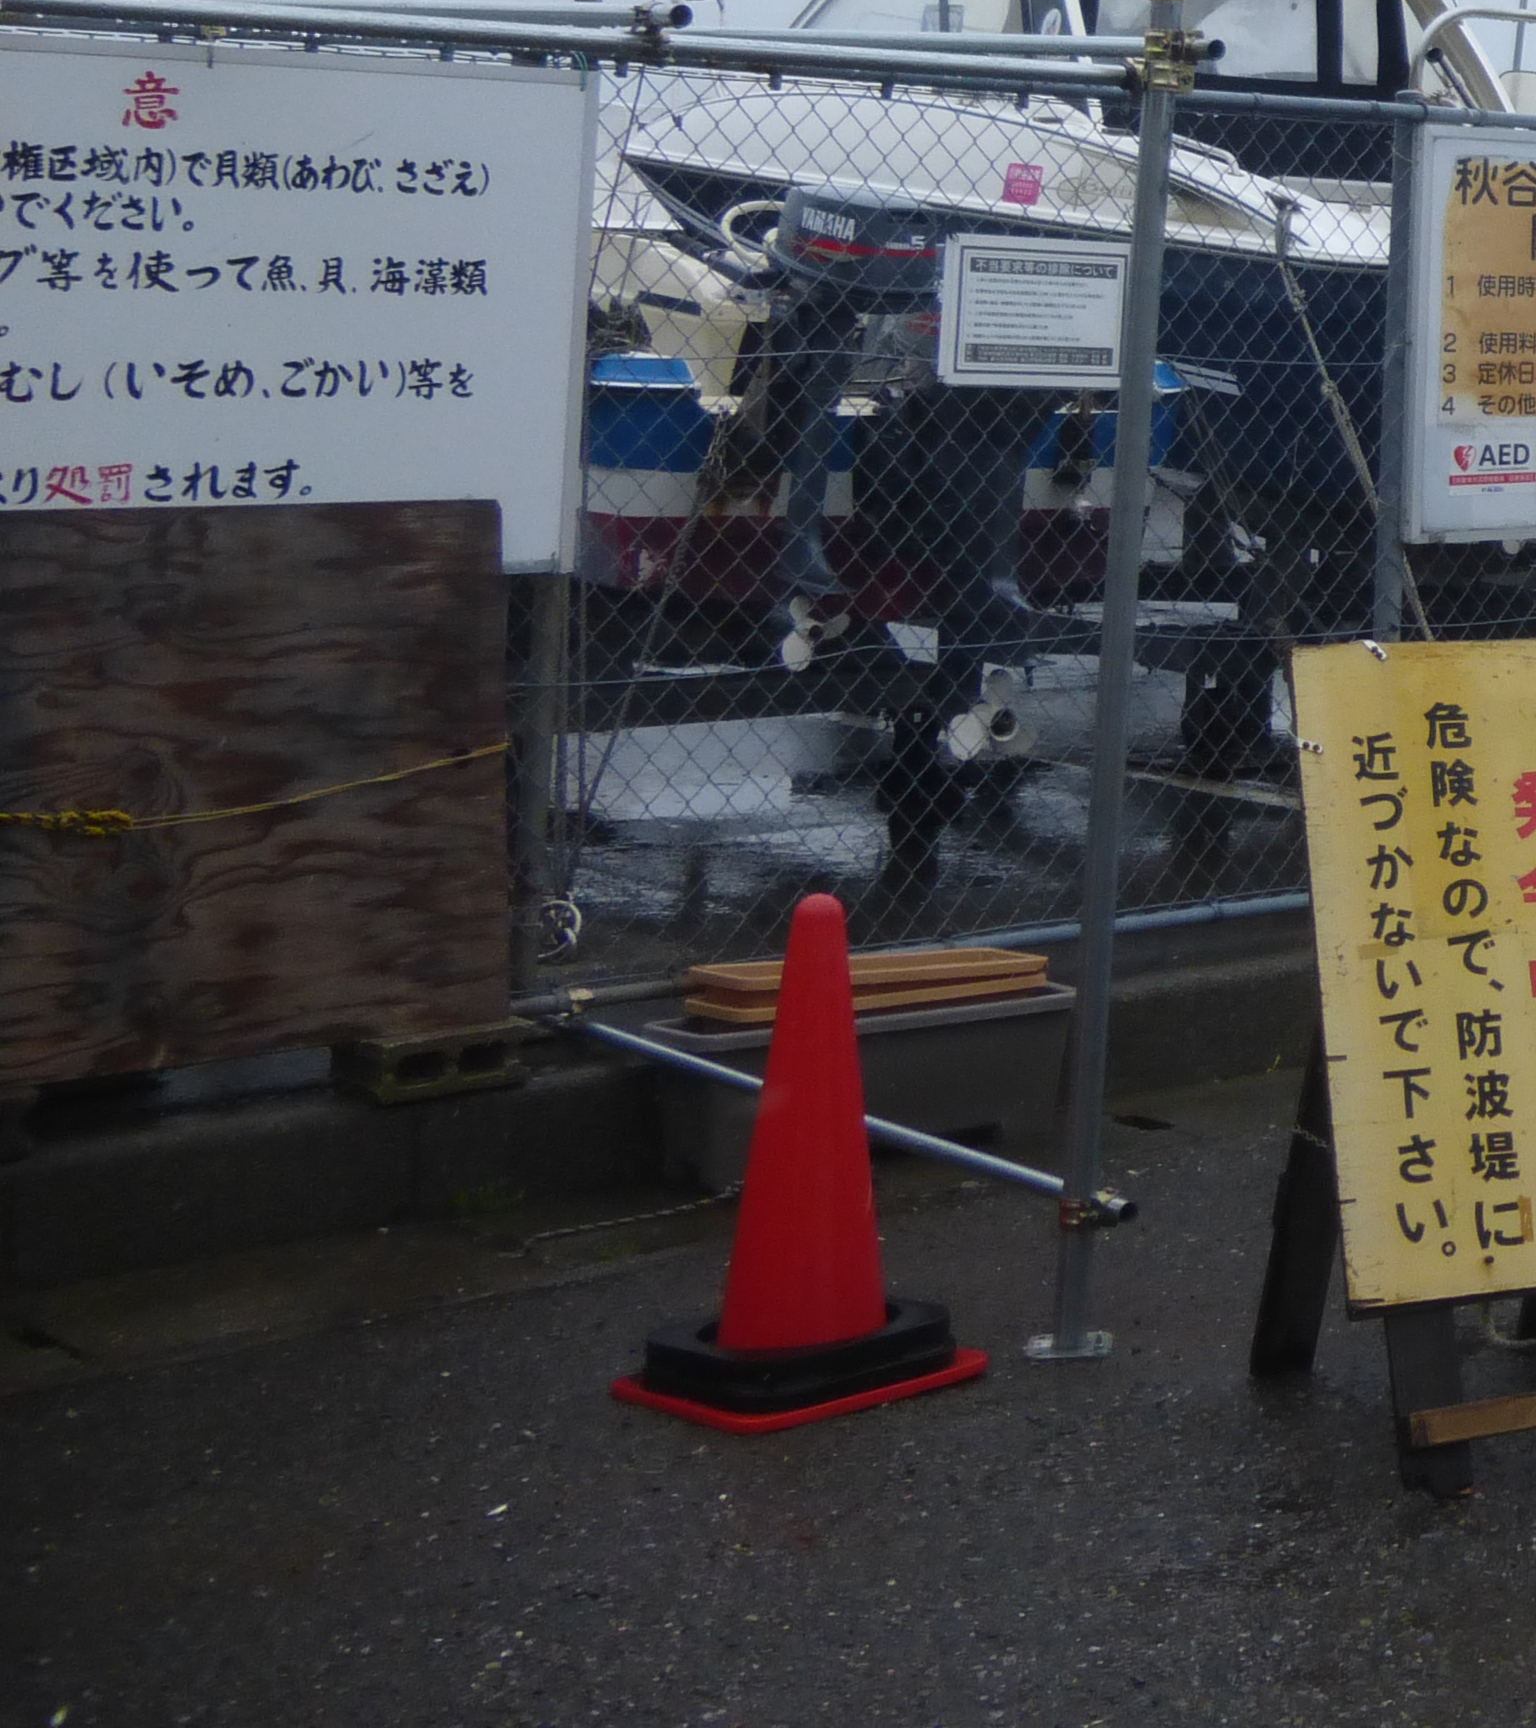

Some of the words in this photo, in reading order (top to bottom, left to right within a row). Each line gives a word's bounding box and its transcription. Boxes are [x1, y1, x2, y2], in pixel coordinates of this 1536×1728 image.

[121, 71, 179, 129] 意
[802, 207, 856, 242] YAMAHA
[1446, 275, 1456, 297] 1
[1443, 333, 1457, 354] 2
[1443, 364, 1457, 384] 3
[1478, 362, 1534, 384] 定休日
[1442, 396, 1455, 414] 4
[1478, 394, 1536, 415] その他
[1479, 443, 1530, 466] AED
[0, 460, 313, 505] り処罰されます。
[1423, 701, 1525, 1249] 危険なので、防波堤に
[1352, 732, 1457, 1258] 近づかないで下さい。
